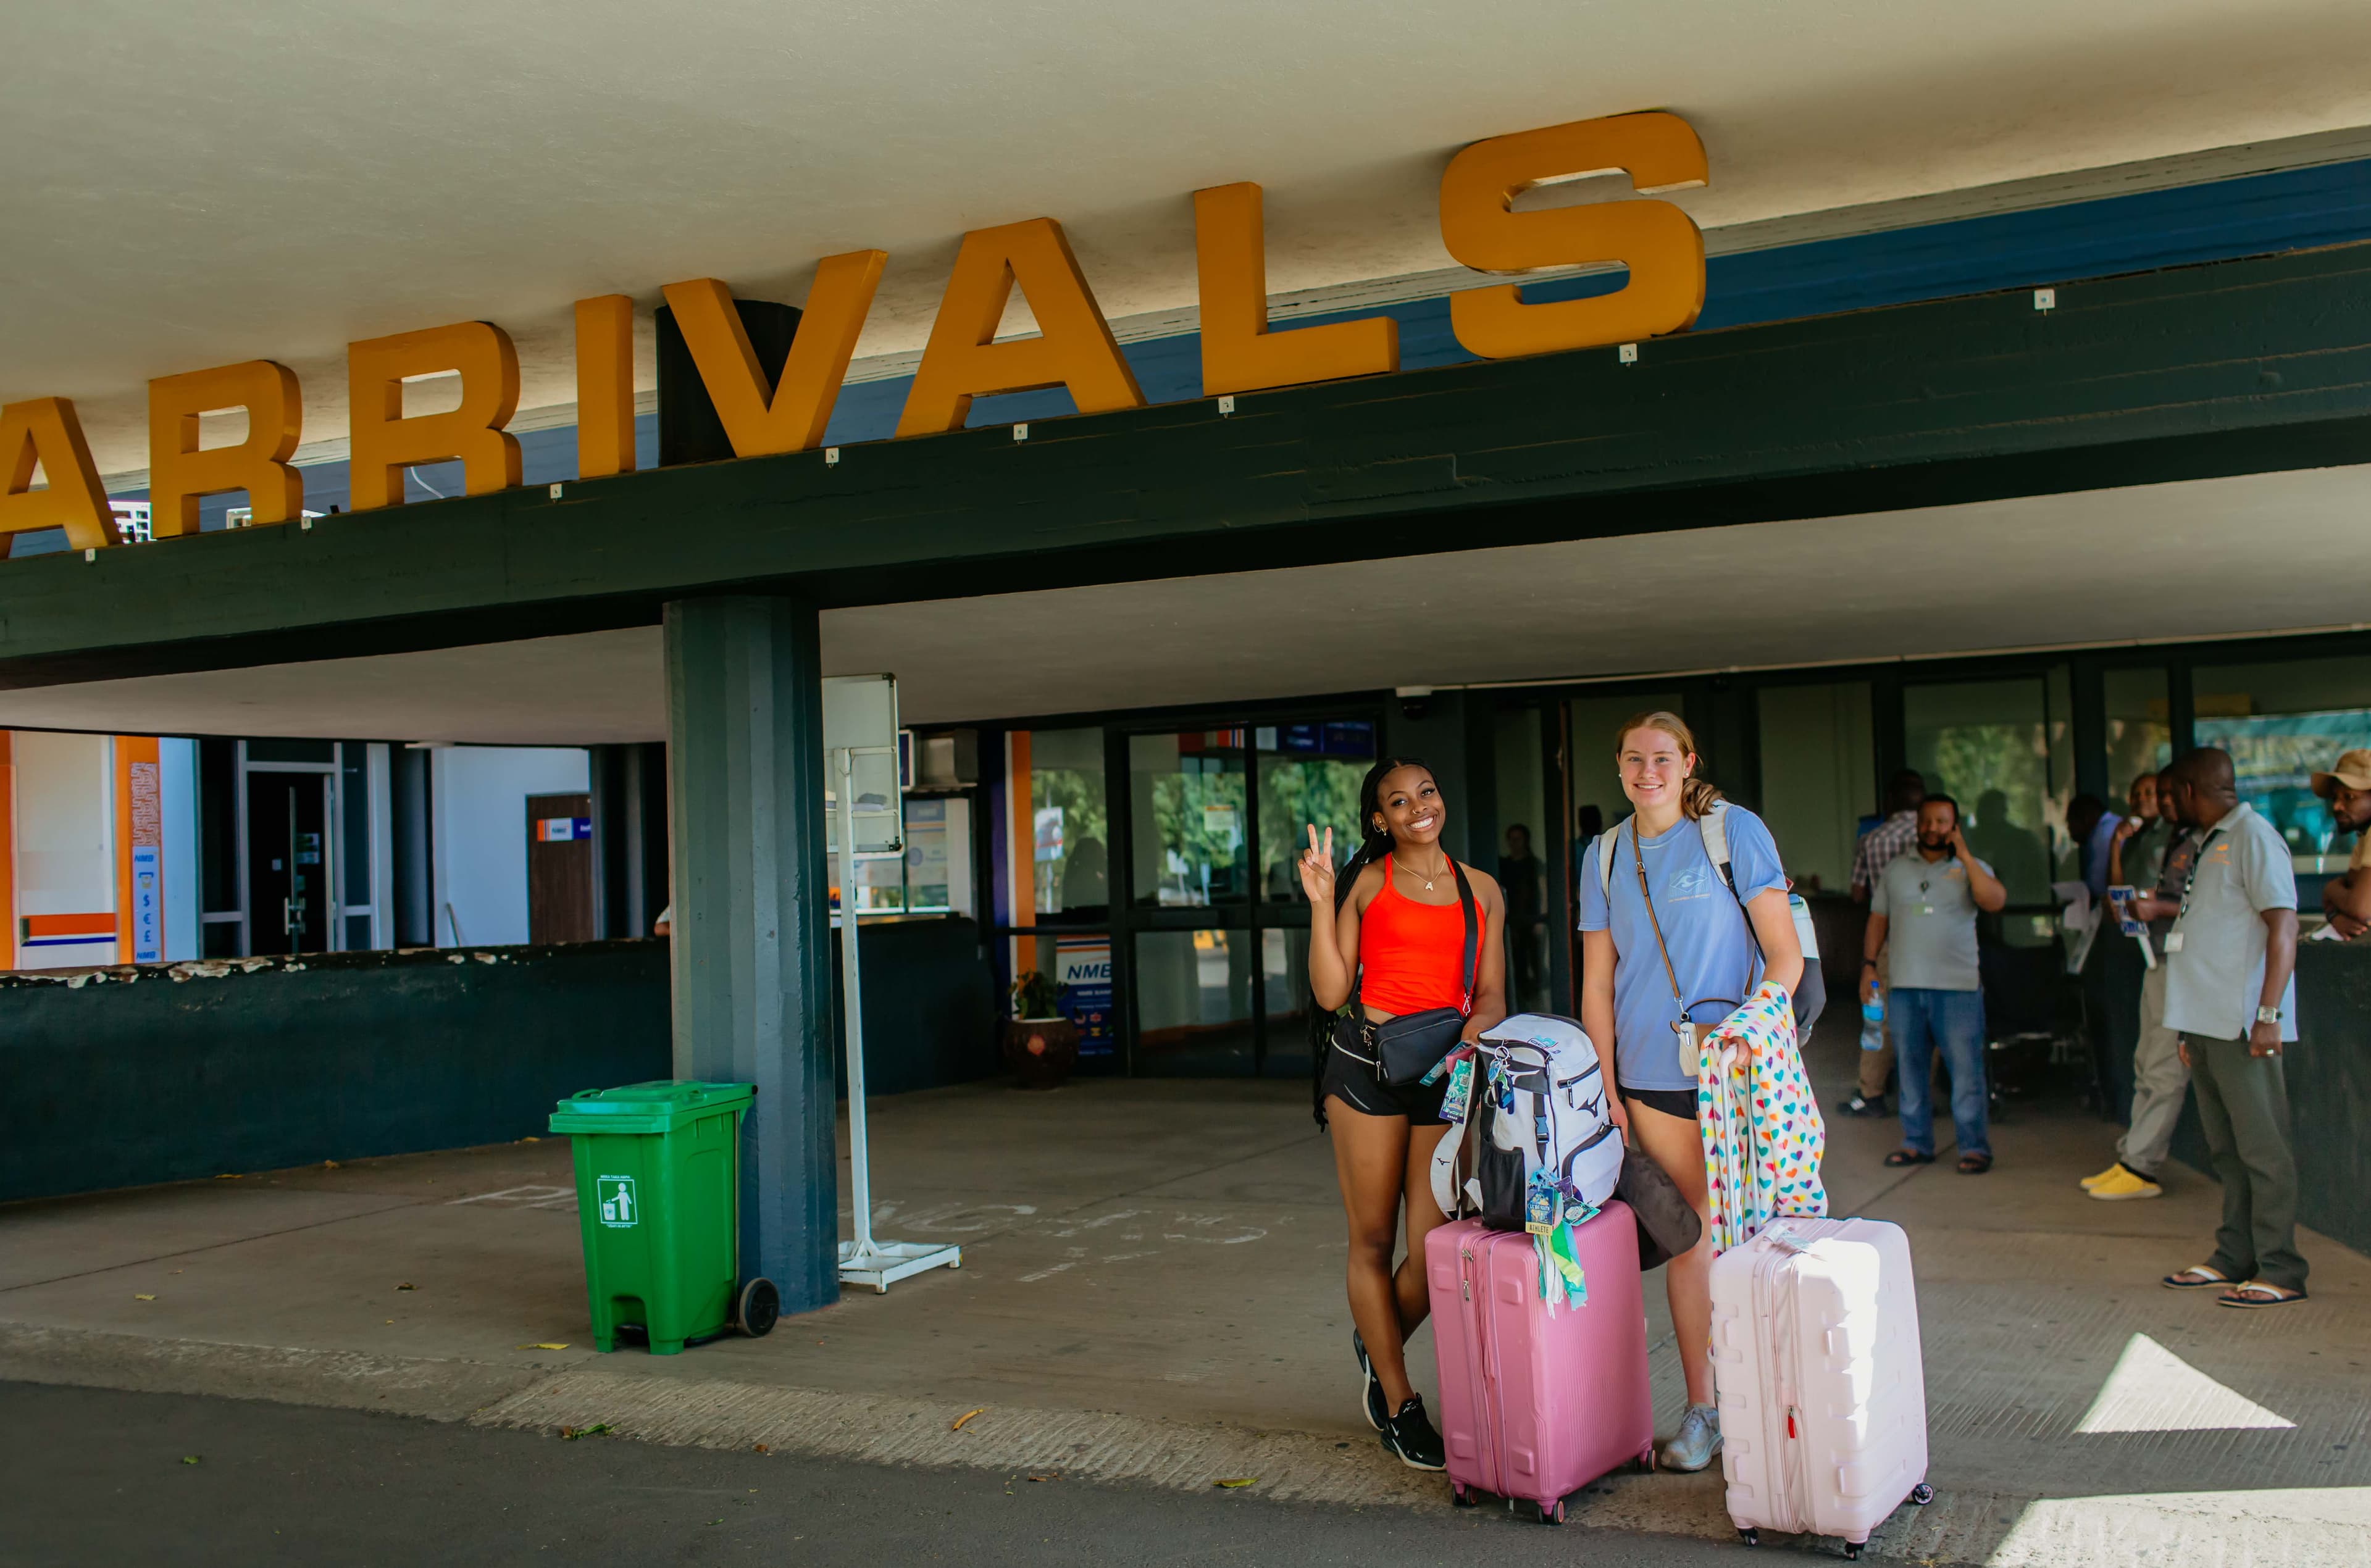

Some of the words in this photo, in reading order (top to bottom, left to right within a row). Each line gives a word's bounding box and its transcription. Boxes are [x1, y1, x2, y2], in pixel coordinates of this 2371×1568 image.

[0, 111, 1708, 559] ARRIVALS
[134, 854, 154, 862] NMB
[136, 951, 156, 959] NMB
[1067, 963, 1111, 980] NMB
[1529, 1224, 1549, 1233] ATHLETE
